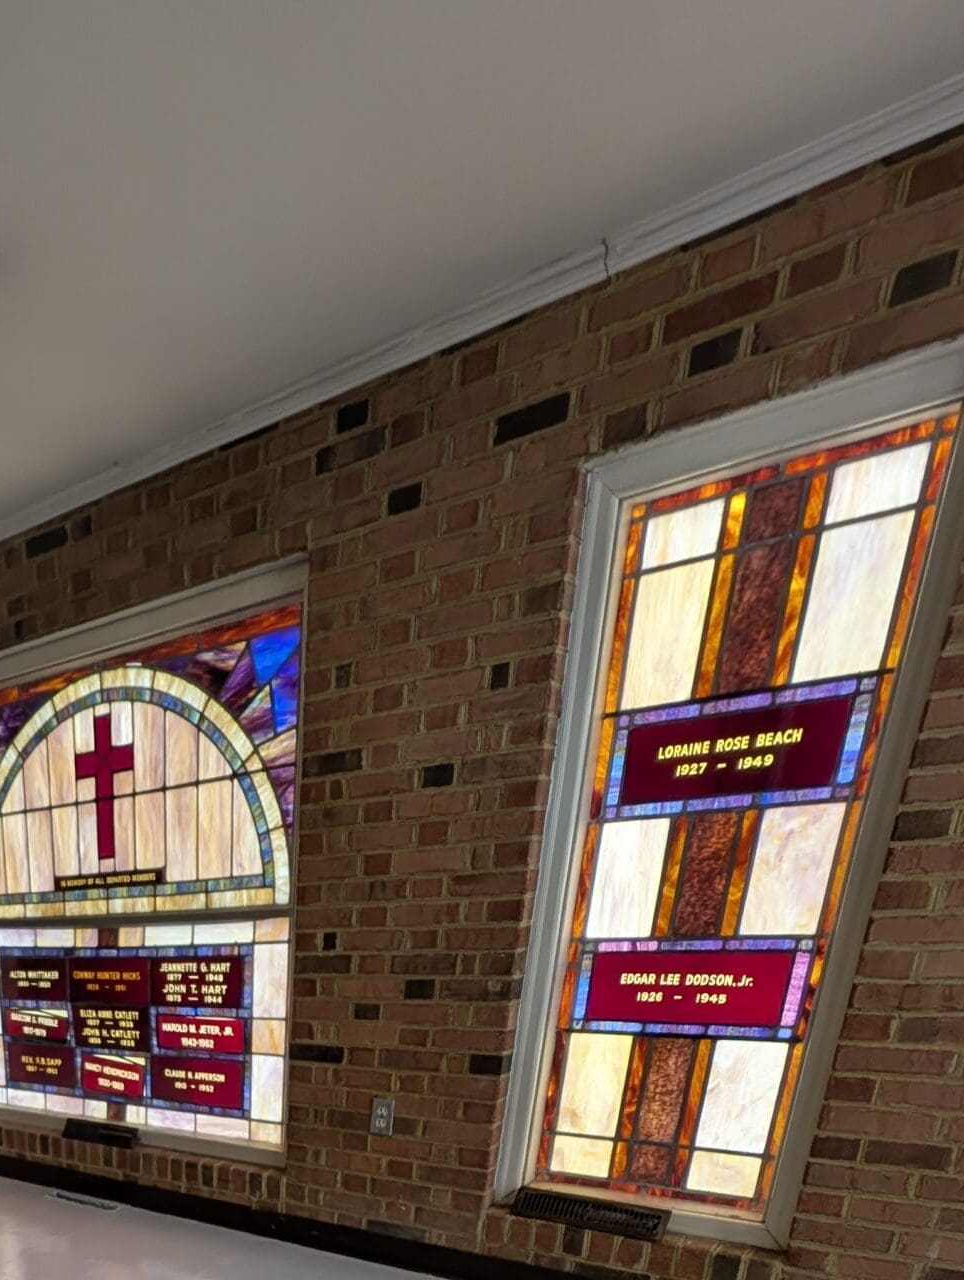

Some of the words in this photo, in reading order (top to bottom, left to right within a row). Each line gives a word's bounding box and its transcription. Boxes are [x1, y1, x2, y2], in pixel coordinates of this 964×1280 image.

[657, 740, 711, 760] LORAINE
[715, 735, 750, 753] ROSE
[755, 727, 804, 747] BEACH
[675, 762, 708, 777] 1927
[737, 754, 774, 771] 1949
[159, 962, 197, 973] JEANNETTE
[200, 963, 208, 973] G.
[210, 962, 231, 973] HART
[96, 971, 121, 980] HUNTER
[620, 973, 656, 985] EDGAR
[660, 973, 681, 986] LEE
[162, 983, 186, 993] JOHN
[201, 984, 228, 995] HART
[637, 992, 663, 1002] 1926
[695, 993, 727, 1004] 1945
[79, 1009, 96, 1018] ELIZA
[114, 1010, 139, 1021] CATLETT
[82, 1027, 100, 1037] JOHN
[110, 1029, 140, 1040] CATLETT
[161, 1022, 188, 1033] HAROLD
[164, 1068, 186, 1080] CLAUDE
